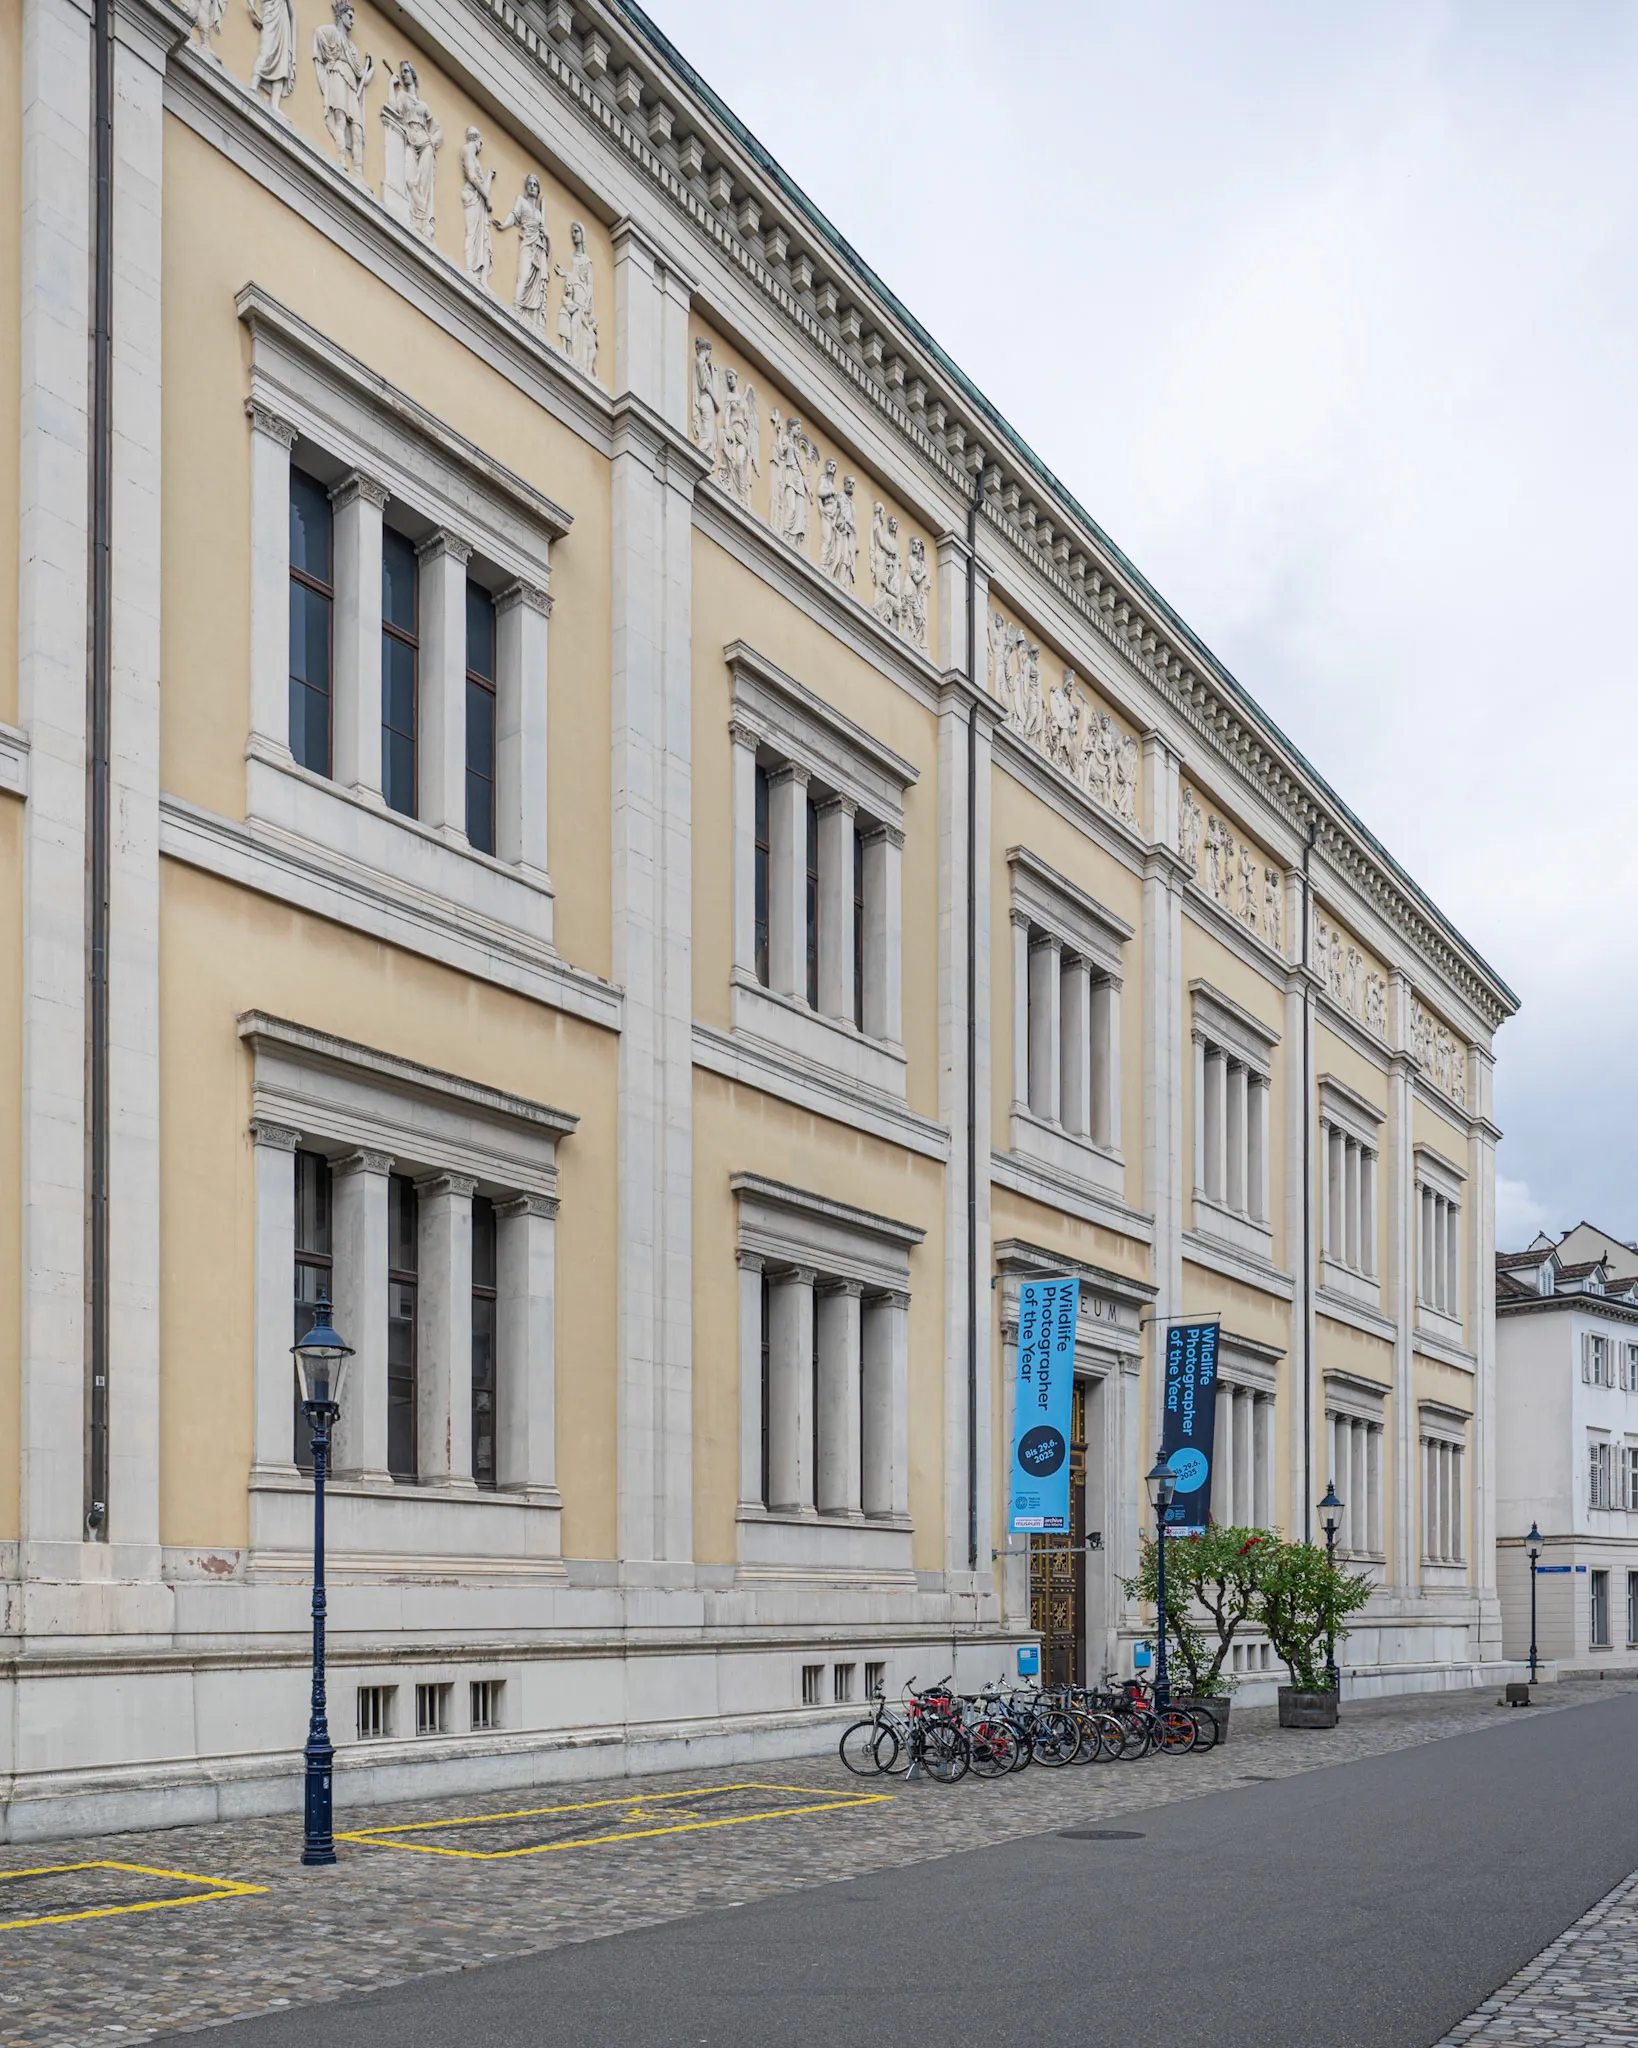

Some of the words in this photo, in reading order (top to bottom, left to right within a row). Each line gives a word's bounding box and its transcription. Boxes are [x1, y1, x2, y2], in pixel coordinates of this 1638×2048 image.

[1025, 1288, 1038, 1306] of
[1080, 1296, 1117, 1322] EUM
[1023, 1310, 1036, 1339] the
[1057, 1283, 1074, 1352] Wildlife
[1036, 1286, 1056, 1411] Photographer
[1170, 1330, 1184, 1347] of
[1021, 1343, 1036, 1383] Year
[1169, 1350, 1182, 1375] the
[1200, 1326, 1215, 1386] Wildlife
[1167, 1376, 1182, 1413] Year
[1182, 1329, 1200, 1436] Photographer
[1025, 1449, 1038, 1459] Bis
[1038, 1439, 1058, 1452] 29.6.
[1034, 1449, 1054, 1464] 2025
[1180, 1468, 1197, 1480] 2025
